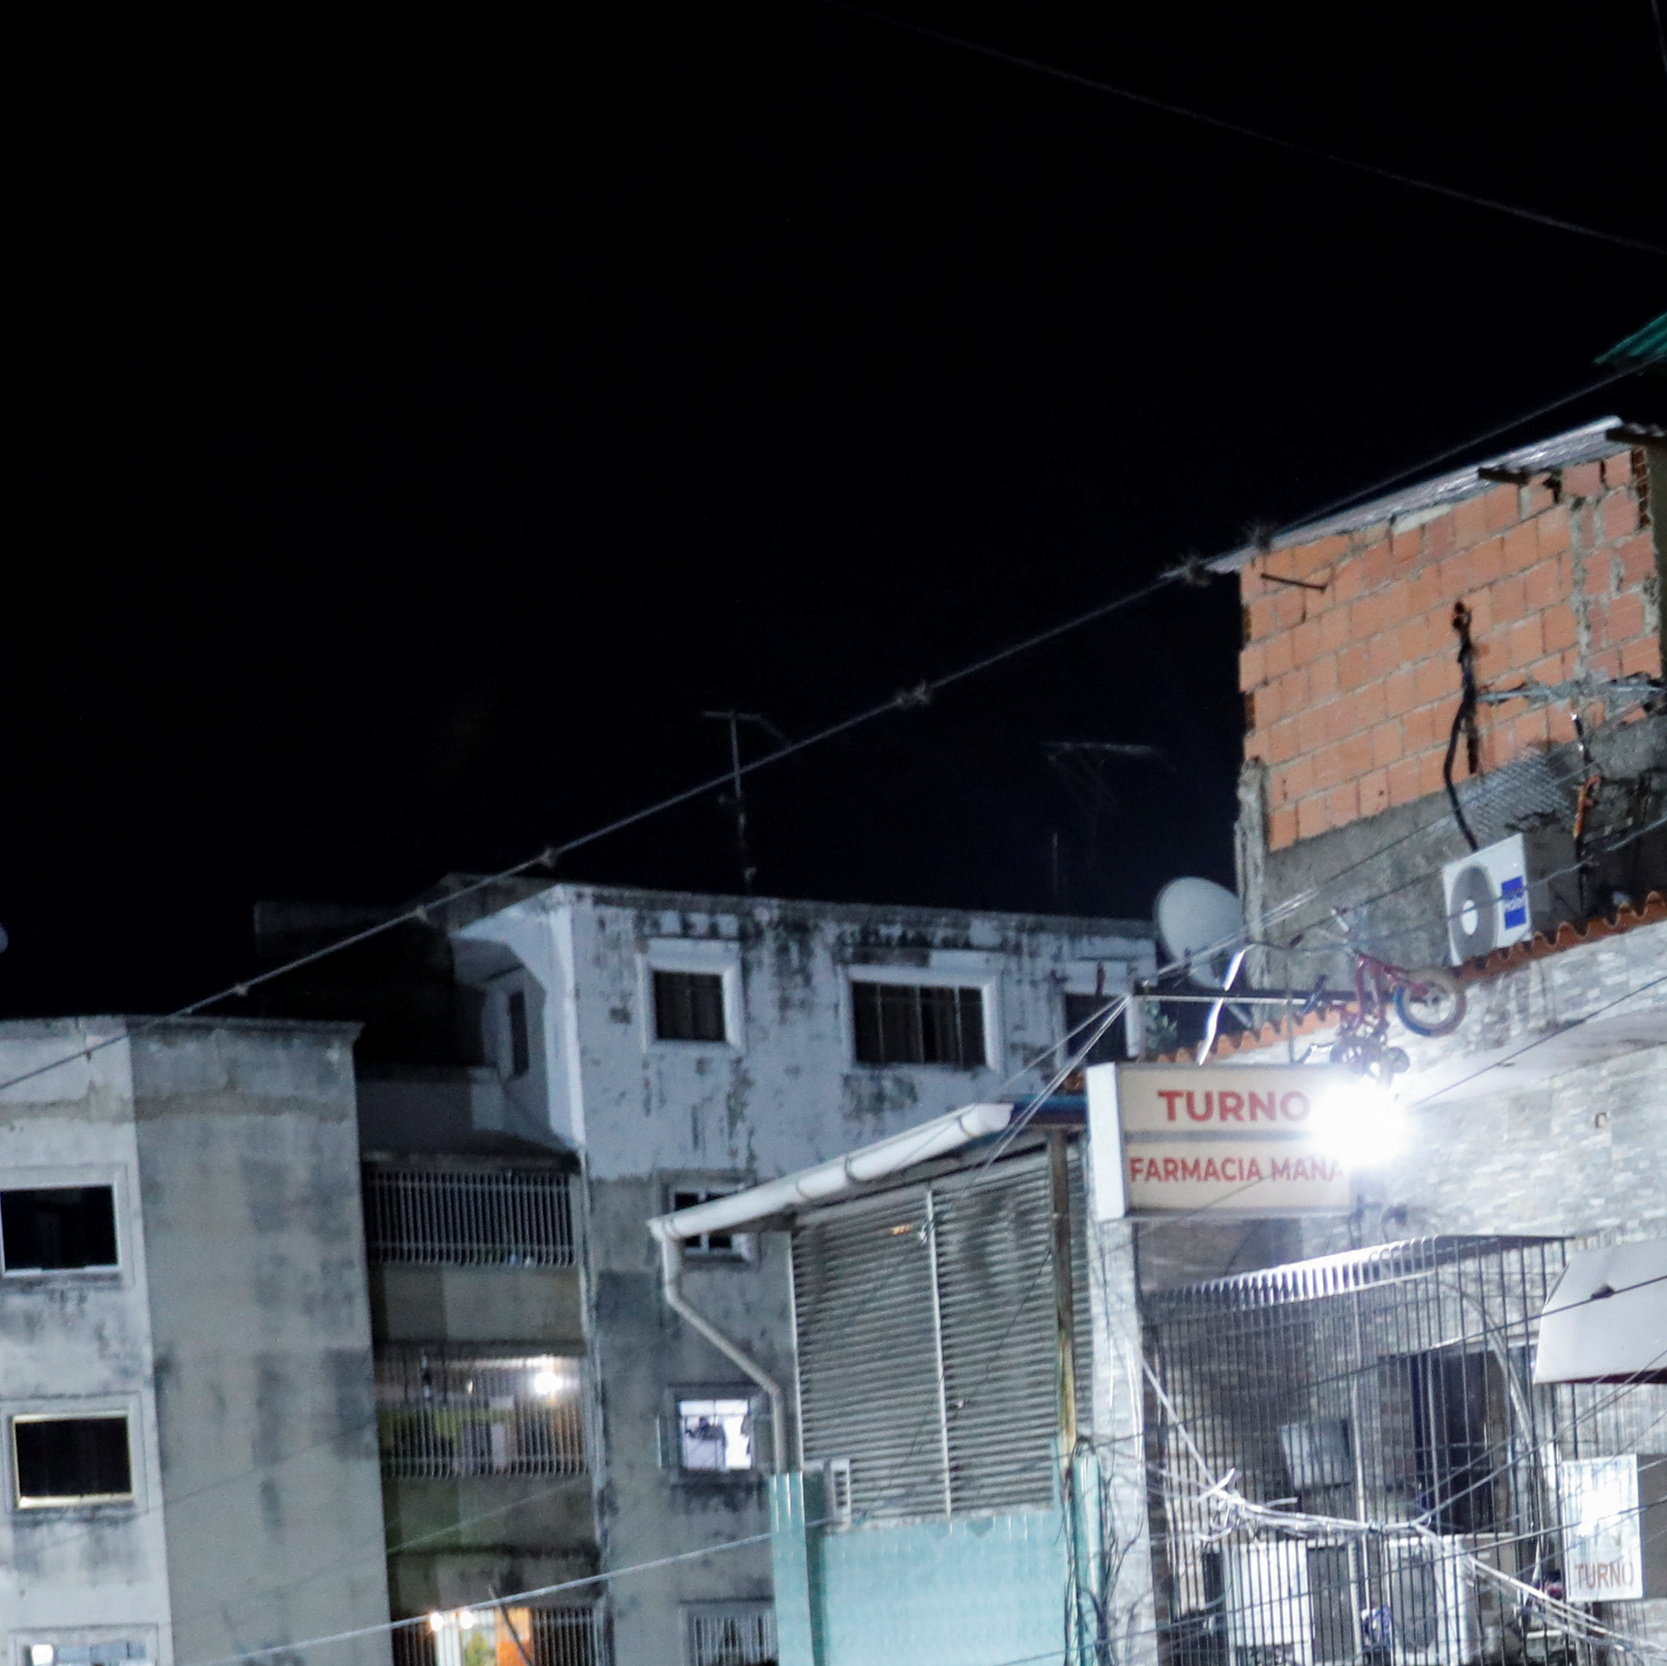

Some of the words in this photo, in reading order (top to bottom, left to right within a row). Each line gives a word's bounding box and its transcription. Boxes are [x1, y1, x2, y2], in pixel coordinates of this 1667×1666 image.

[1157, 1091, 1311, 1121] TURNO
[1130, 1157, 1263, 1182] FARMACIA
[1574, 1563, 1634, 1588] TURNO
